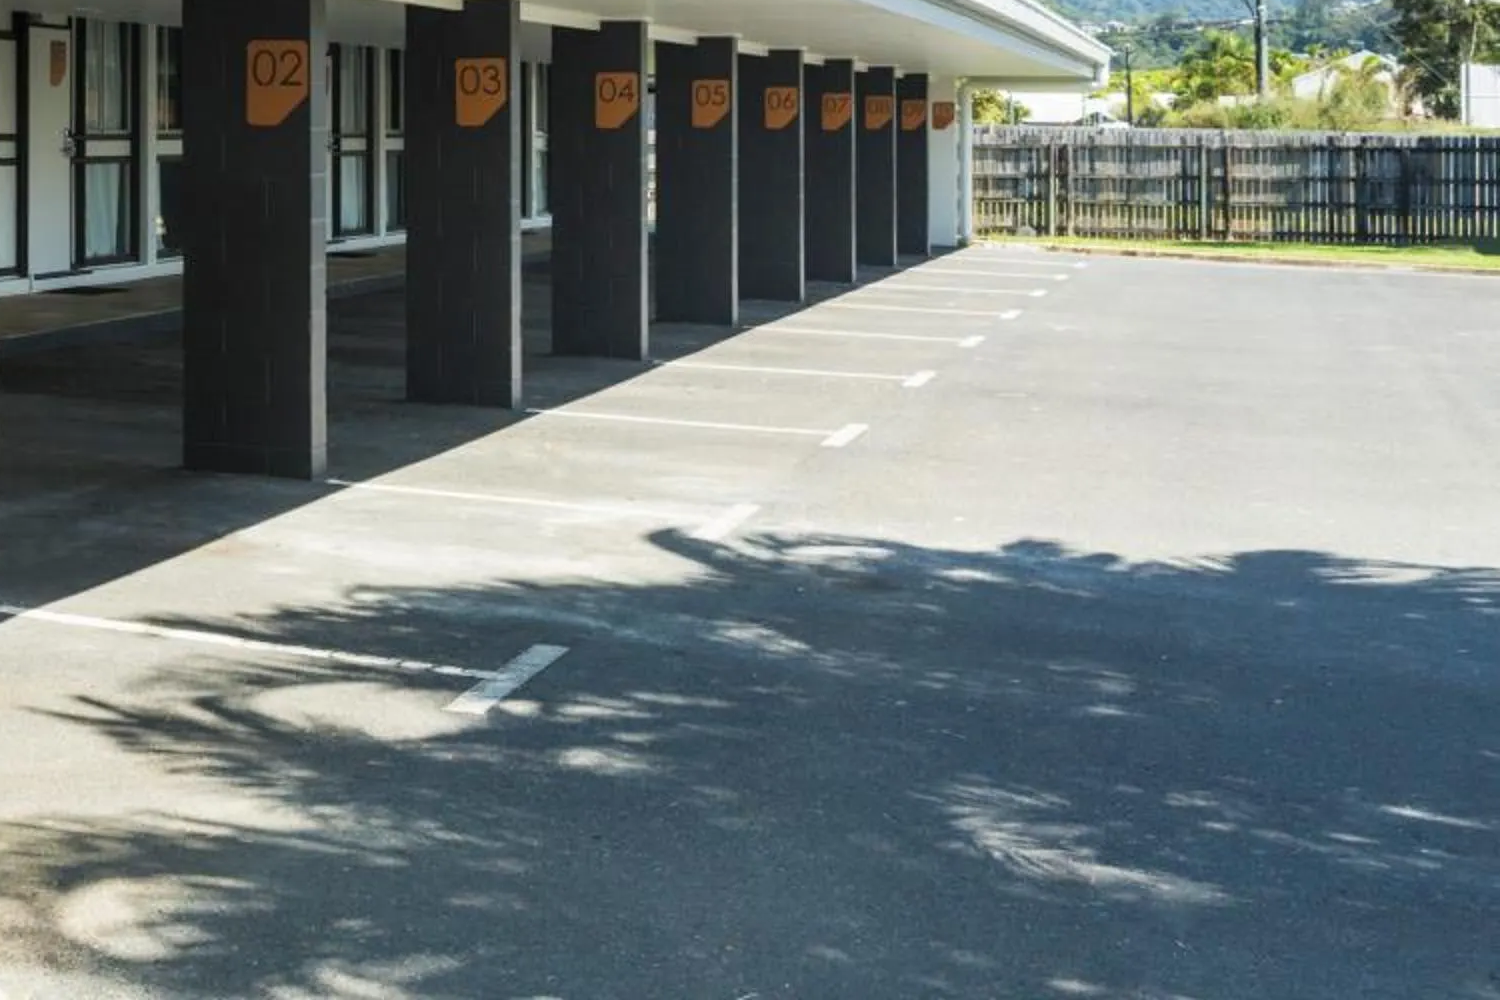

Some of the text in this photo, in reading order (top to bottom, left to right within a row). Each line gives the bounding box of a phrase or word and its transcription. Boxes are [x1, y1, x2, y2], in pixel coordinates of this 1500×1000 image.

[251, 48, 303, 87] 02
[459, 65, 501, 96] 03
[599, 78, 635, 103] 04
[695, 85, 726, 107] 05
[767, 90, 795, 111] 06
